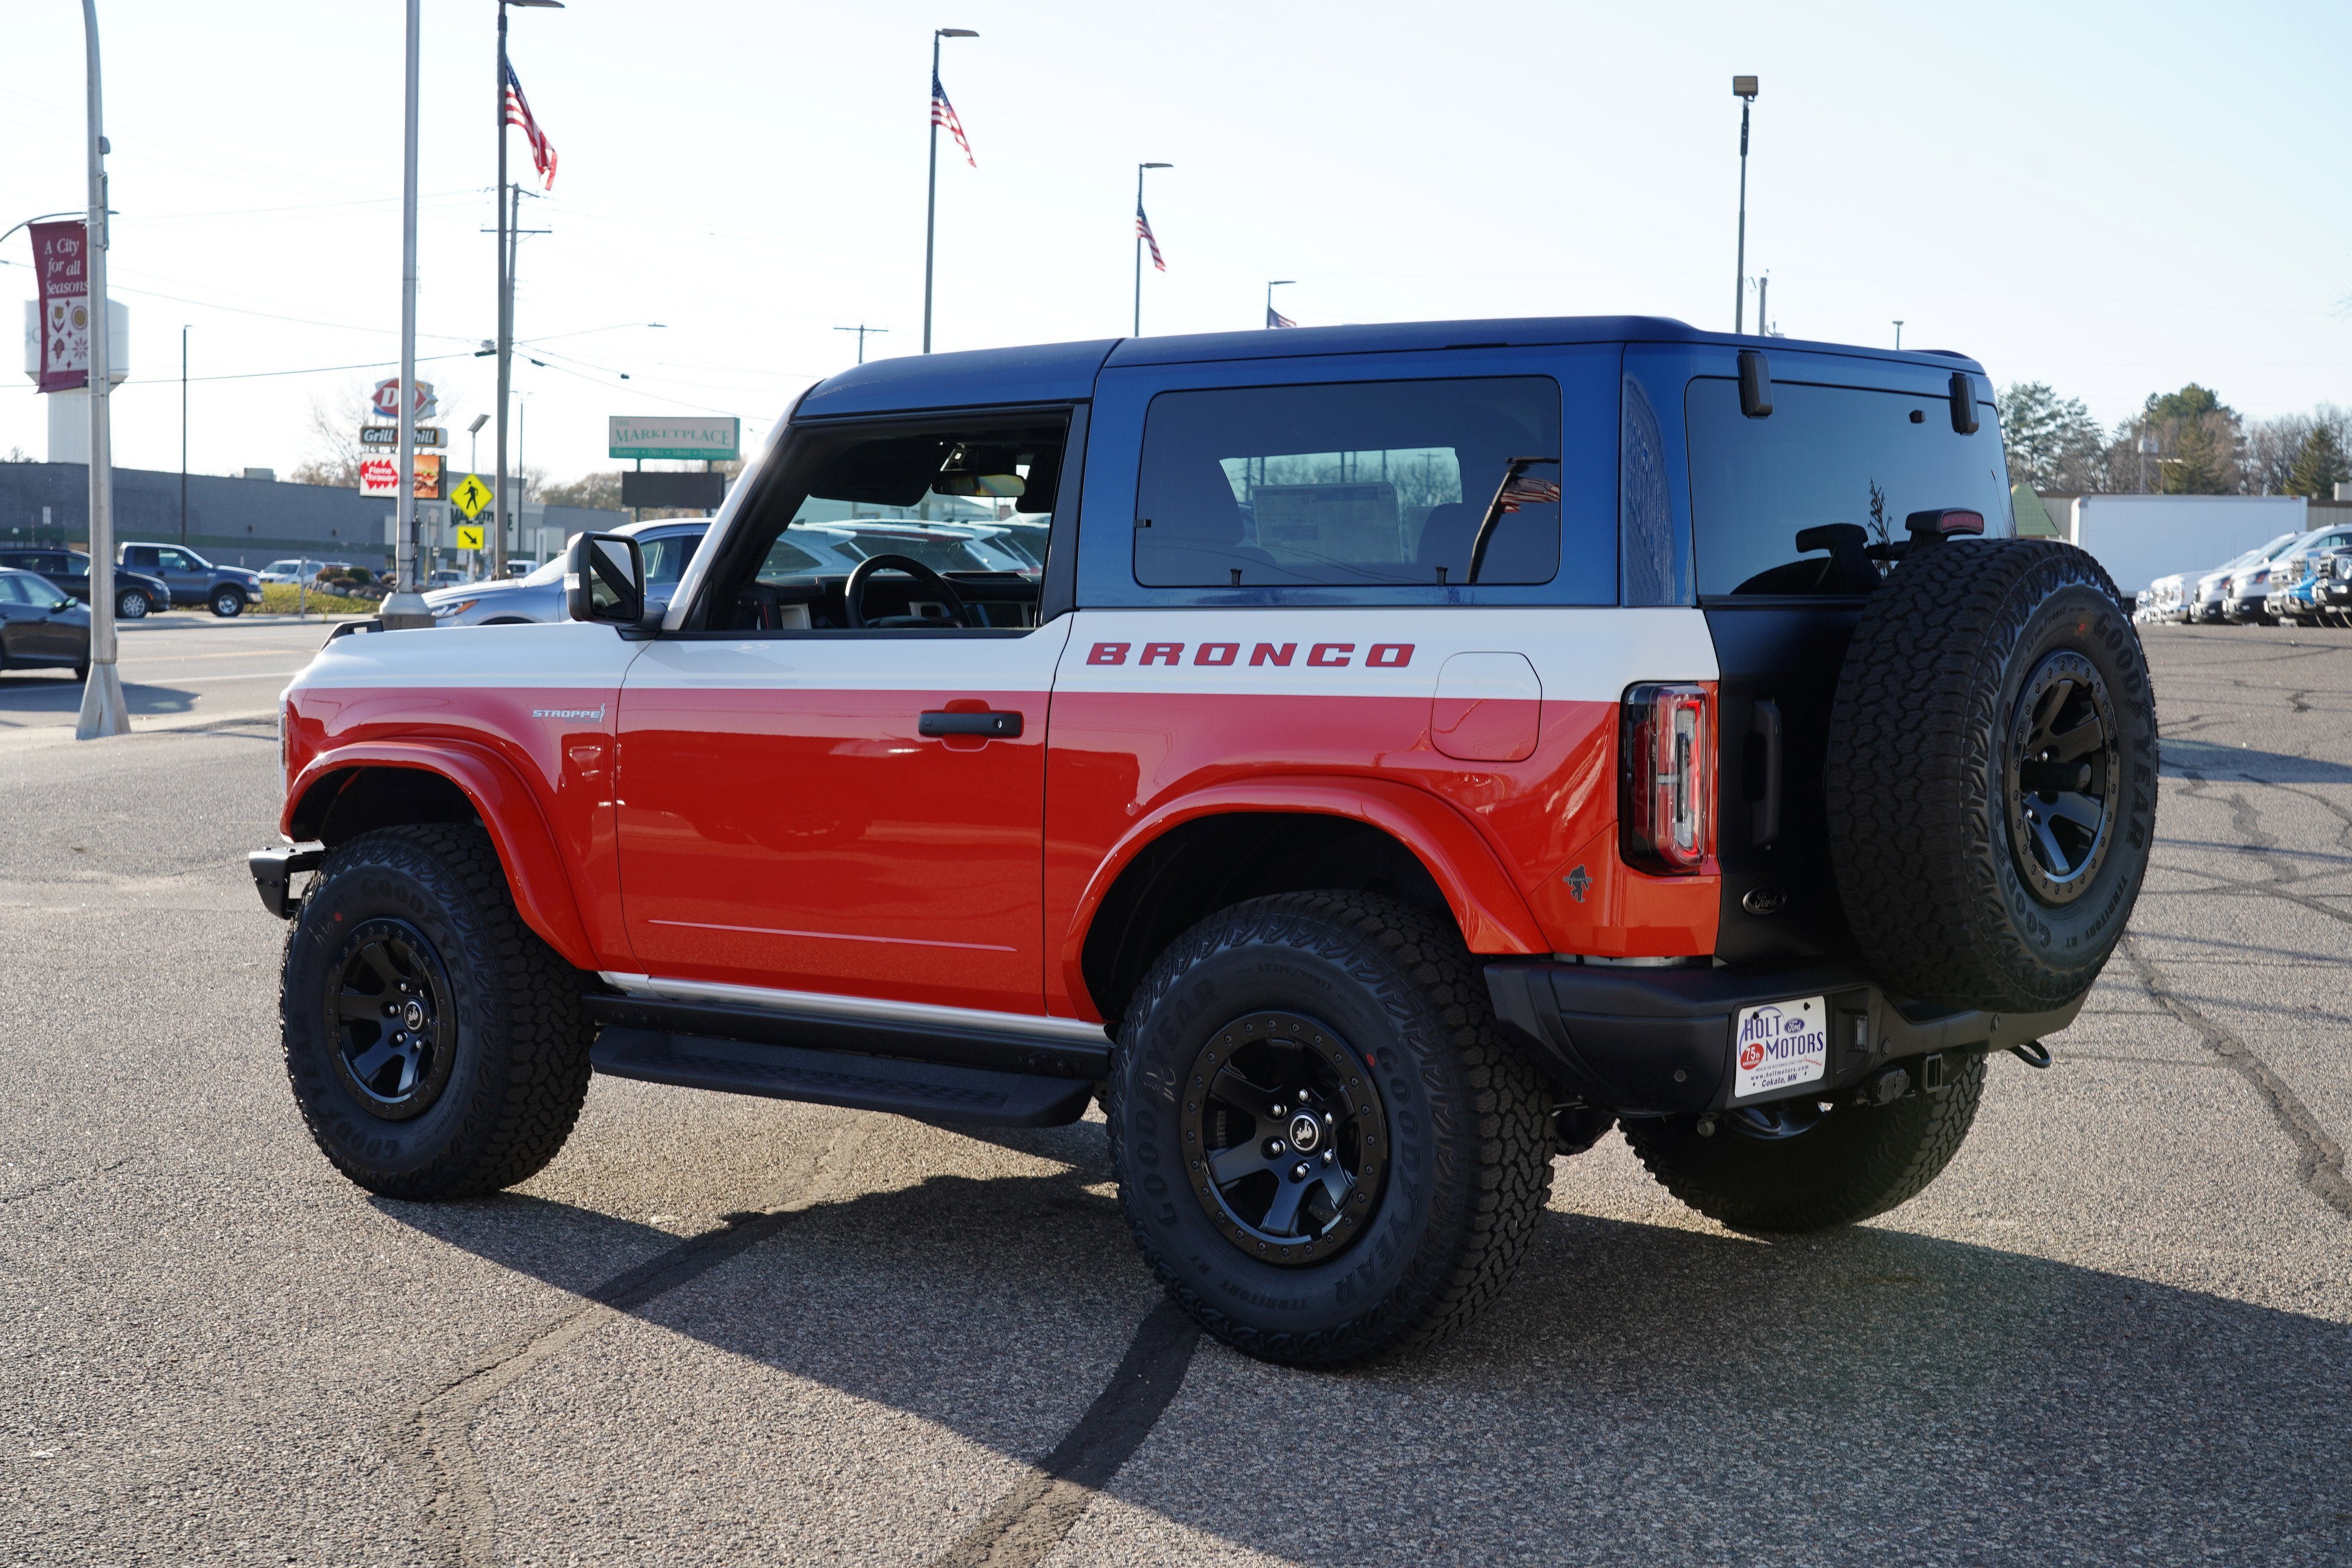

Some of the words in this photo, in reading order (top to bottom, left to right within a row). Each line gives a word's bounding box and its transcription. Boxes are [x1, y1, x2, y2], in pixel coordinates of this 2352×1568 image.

[44, 240, 52, 255] A
[57, 237, 79, 256] City
[47, 258, 64, 277] for
[66, 260, 81, 276] all
[46, 280, 88, 295] Seasons
[364, 430, 394, 442] Grill
[614, 429, 730, 445] MARKETPLACE
[1086, 642, 1416, 667] BRONCO
[532, 709, 600, 718] STROPPE
[2093, 612, 2152, 852] GOODYEAR
[1754, 893, 1779, 908] Ford
[2086, 875, 2129, 942] TERRITORY
[361, 878, 471, 1028] GOODYEAR
[1744, 1015, 1781, 1041] HOLT
[1787, 1019, 1802, 1033] Ford
[1745, 1046, 1760, 1061] 75th
[1766, 1032, 1823, 1062] MOTORS
[1750, 1065, 1809, 1081] www.holtmotors.com
[1762, 1077, 1786, 1087] Cokato,
[1787, 1073, 1797, 1082] MN
[292, 1013, 400, 1160] GOODYEAR
[1132, 978, 1220, 1226] GOODYEAR
[1334, 1046, 1423, 1304] GOODYEAR
[1219, 1279, 1310, 1310] TERRITORY
